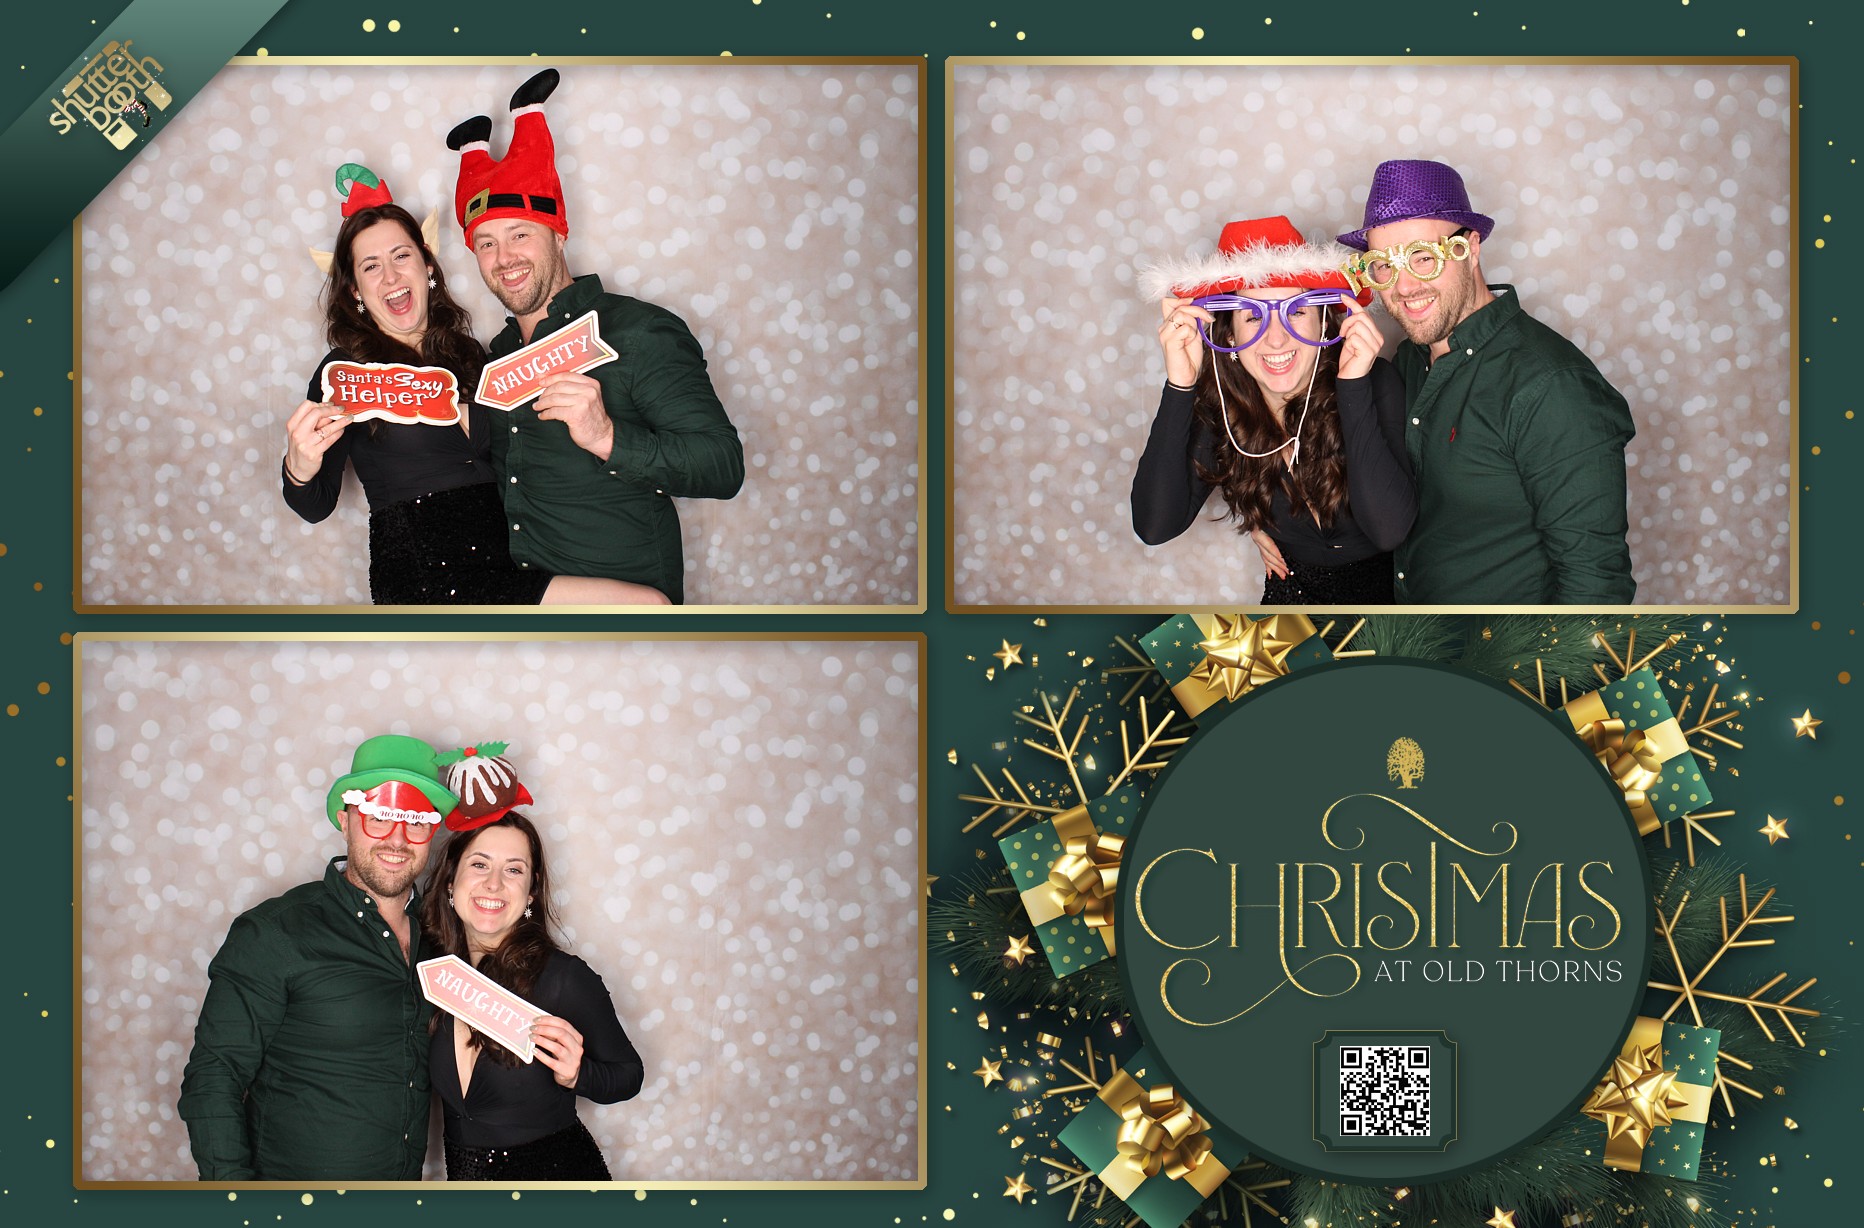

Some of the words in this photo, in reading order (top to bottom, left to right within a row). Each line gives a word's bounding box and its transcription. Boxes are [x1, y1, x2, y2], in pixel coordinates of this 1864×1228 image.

[336, 371, 392, 385] Santa's
[393, 372, 443, 399] Sexy
[491, 335, 589, 396] NAUGHTY
[339, 385, 430, 408] Helper
[434, 968, 531, 1034] NAUGHTY
